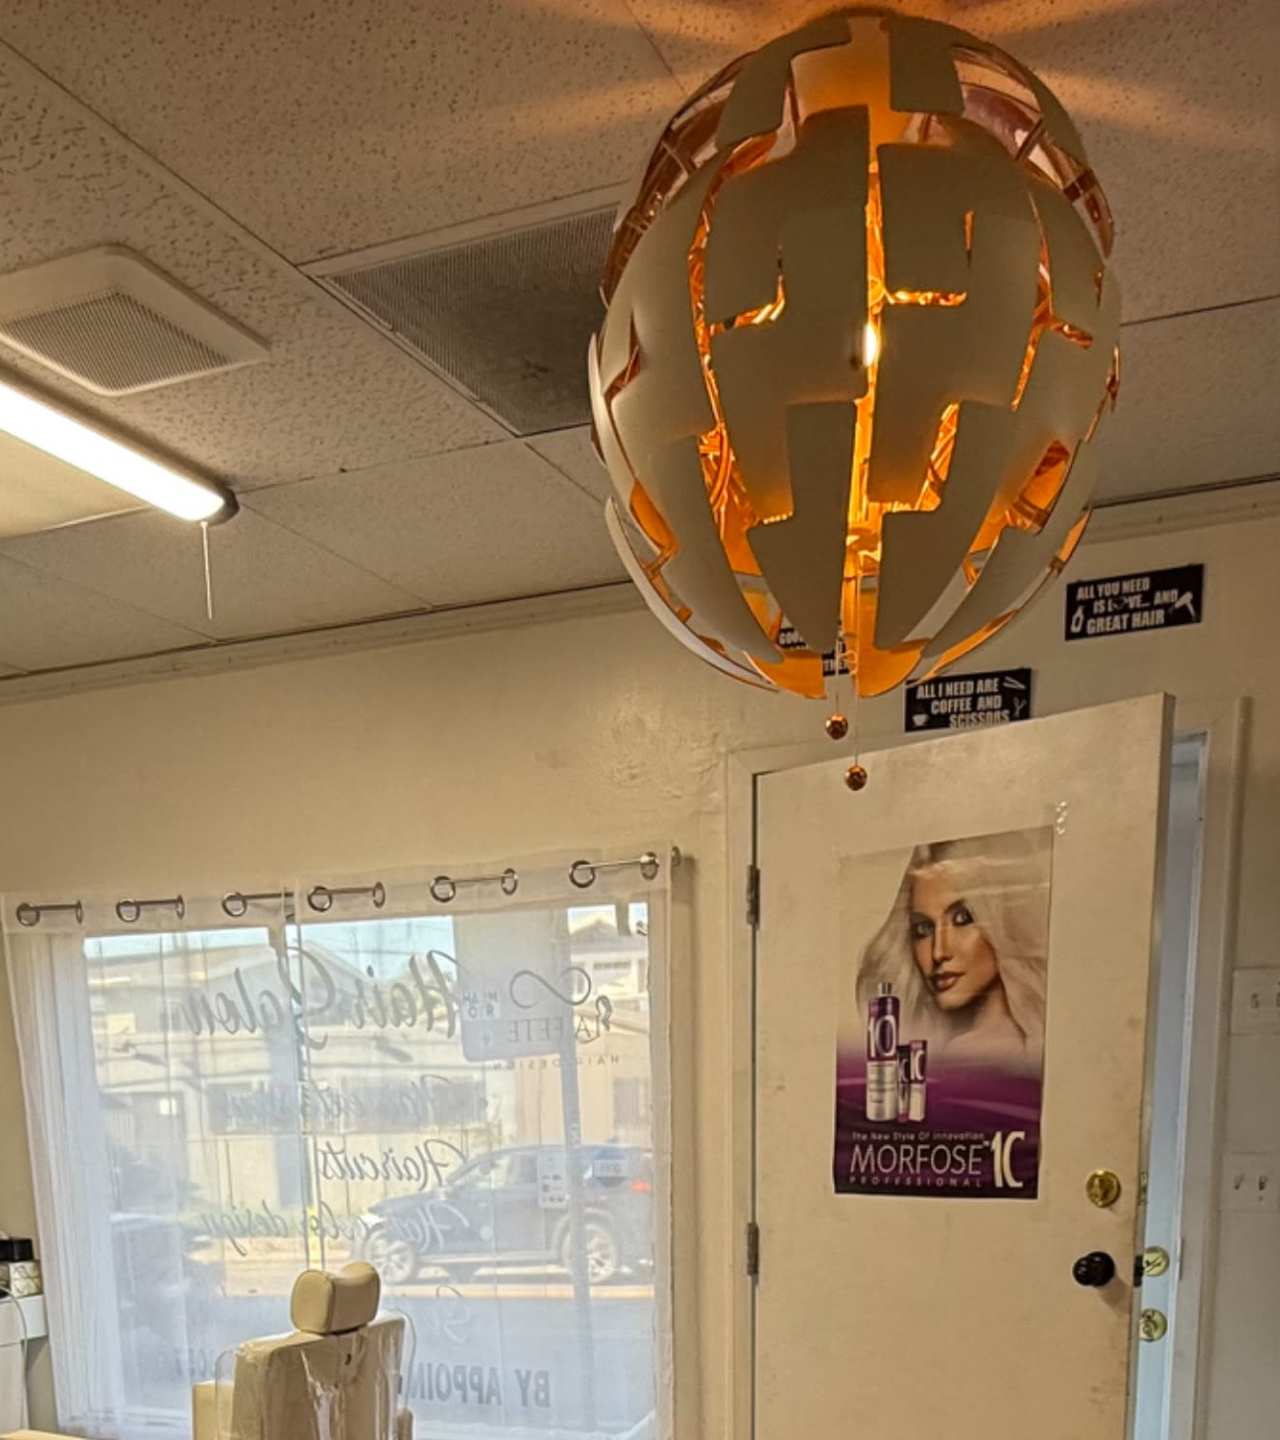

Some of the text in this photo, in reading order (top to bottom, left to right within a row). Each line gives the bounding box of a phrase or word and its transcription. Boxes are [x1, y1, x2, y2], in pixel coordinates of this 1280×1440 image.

[1076, 577, 1151, 601] ALL YOU NEED
[1153, 589, 1179, 606] AND
[1086, 609, 1165, 634] GREAT HAIR
[916, 683, 936, 699] ALL
[944, 679, 975, 696] NEED
[976, 677, 1001, 694] ARE
[930, 694, 1002, 715] COFFEE AND
[849, 1144, 984, 1176] MORFOSE
